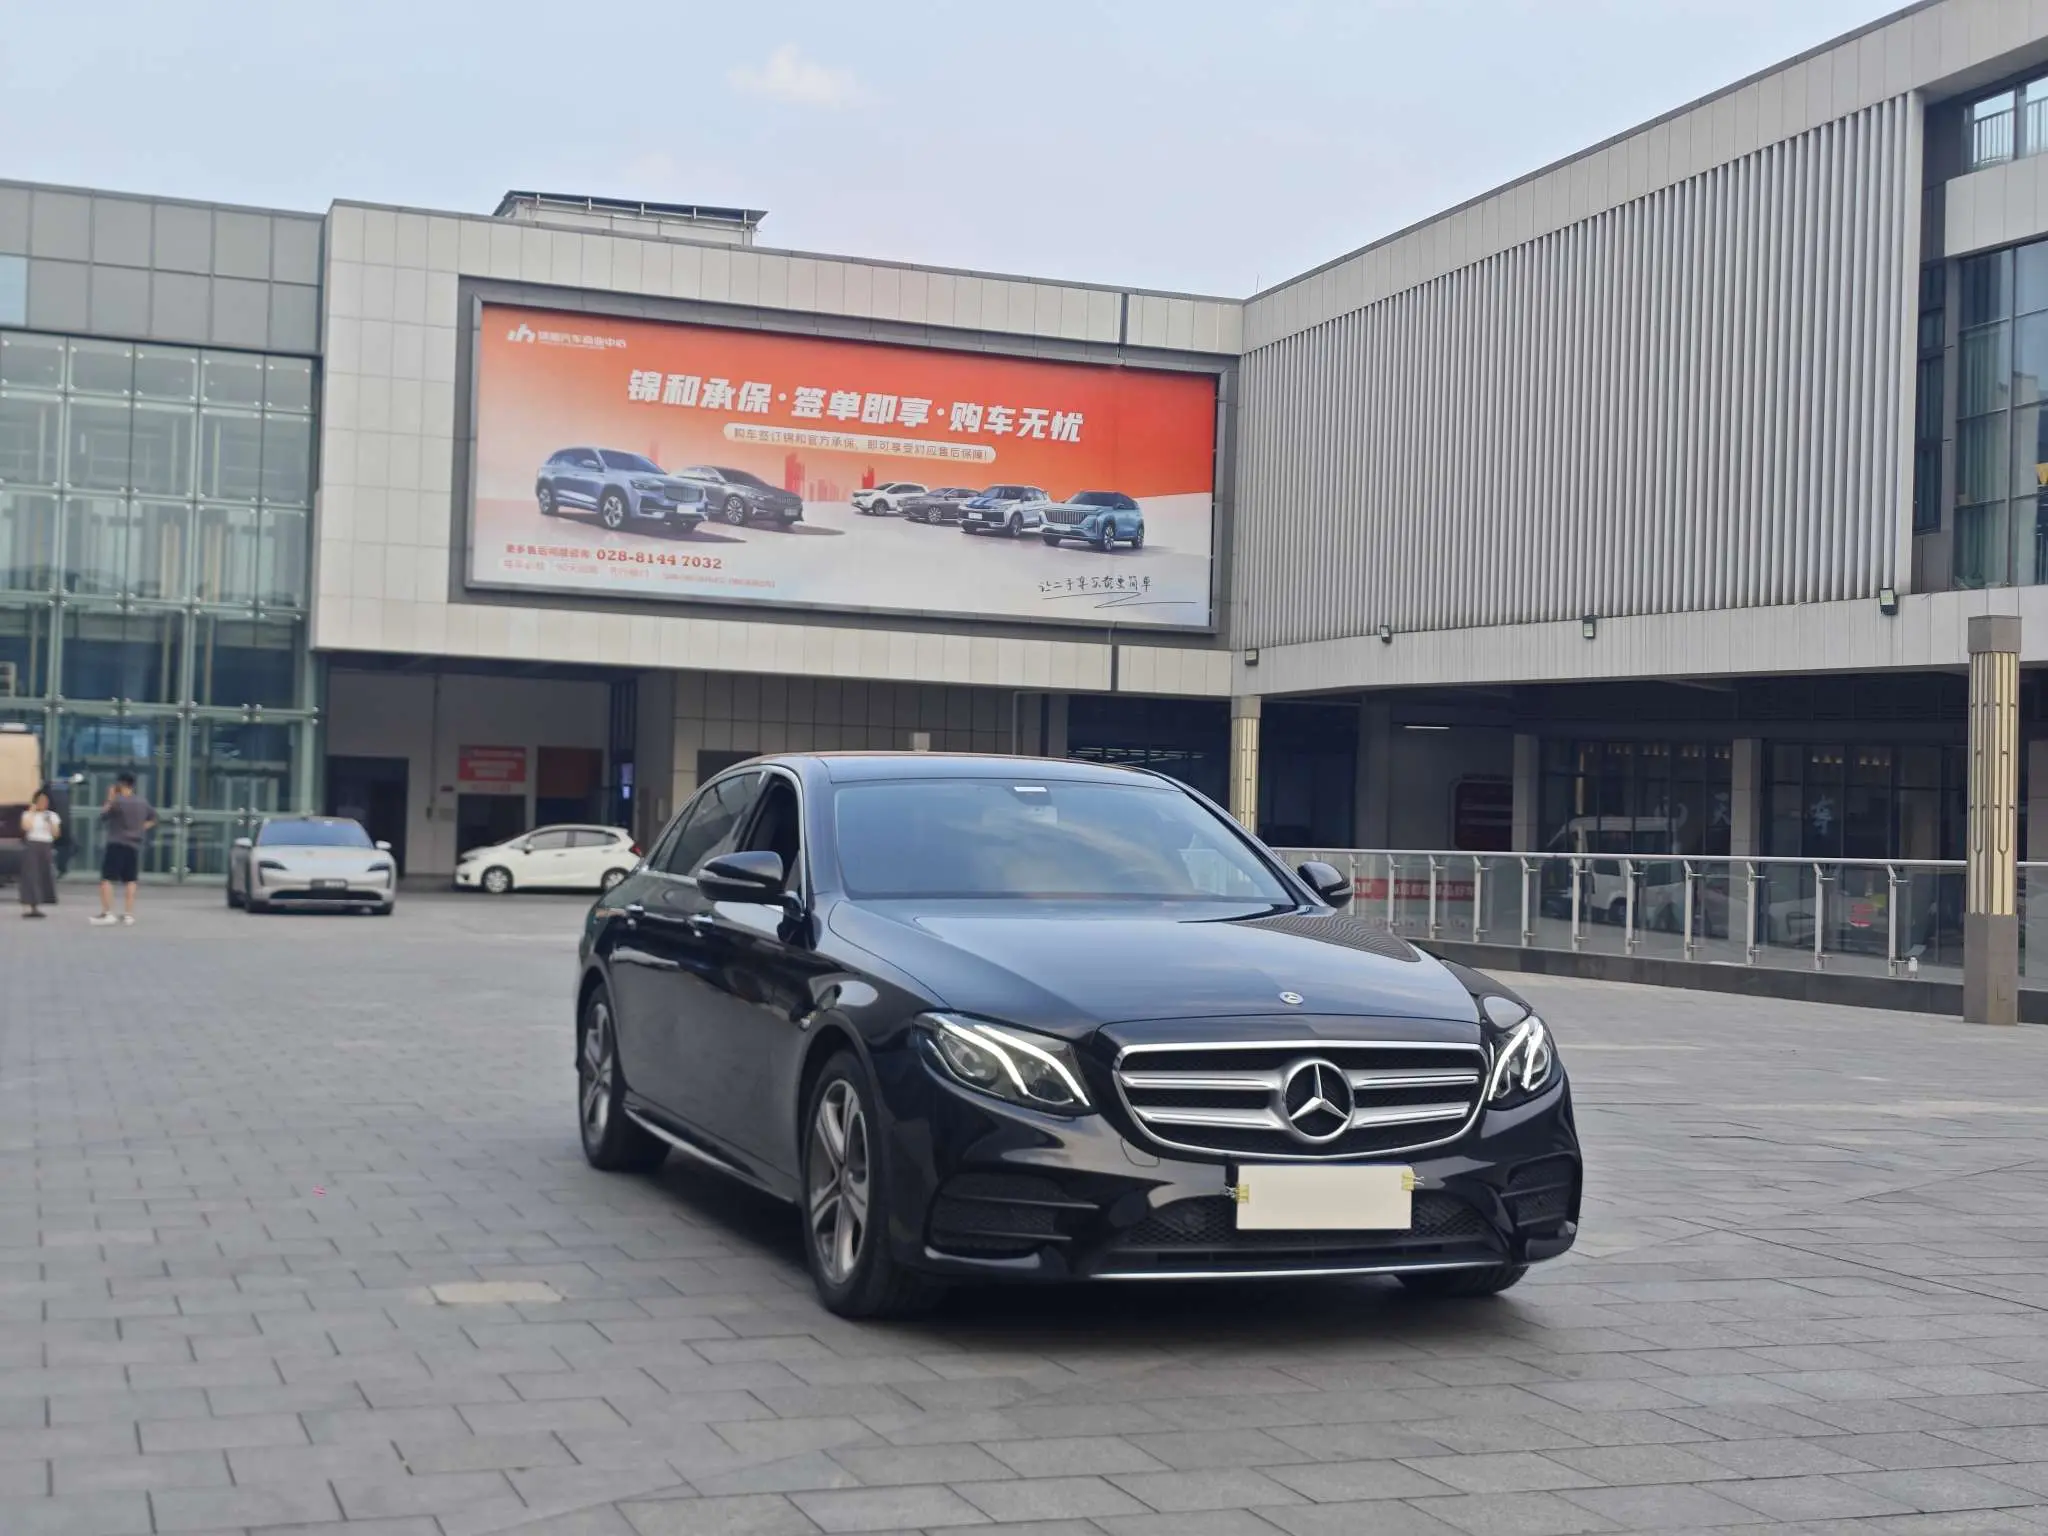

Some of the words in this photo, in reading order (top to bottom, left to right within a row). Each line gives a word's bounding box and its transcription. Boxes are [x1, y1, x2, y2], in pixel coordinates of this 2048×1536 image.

[627, 369, 1085, 443] 锦和承保·签单即享·购车无忧
[596, 548, 677, 567] 028-8144
[681, 554, 723, 570] 7032
